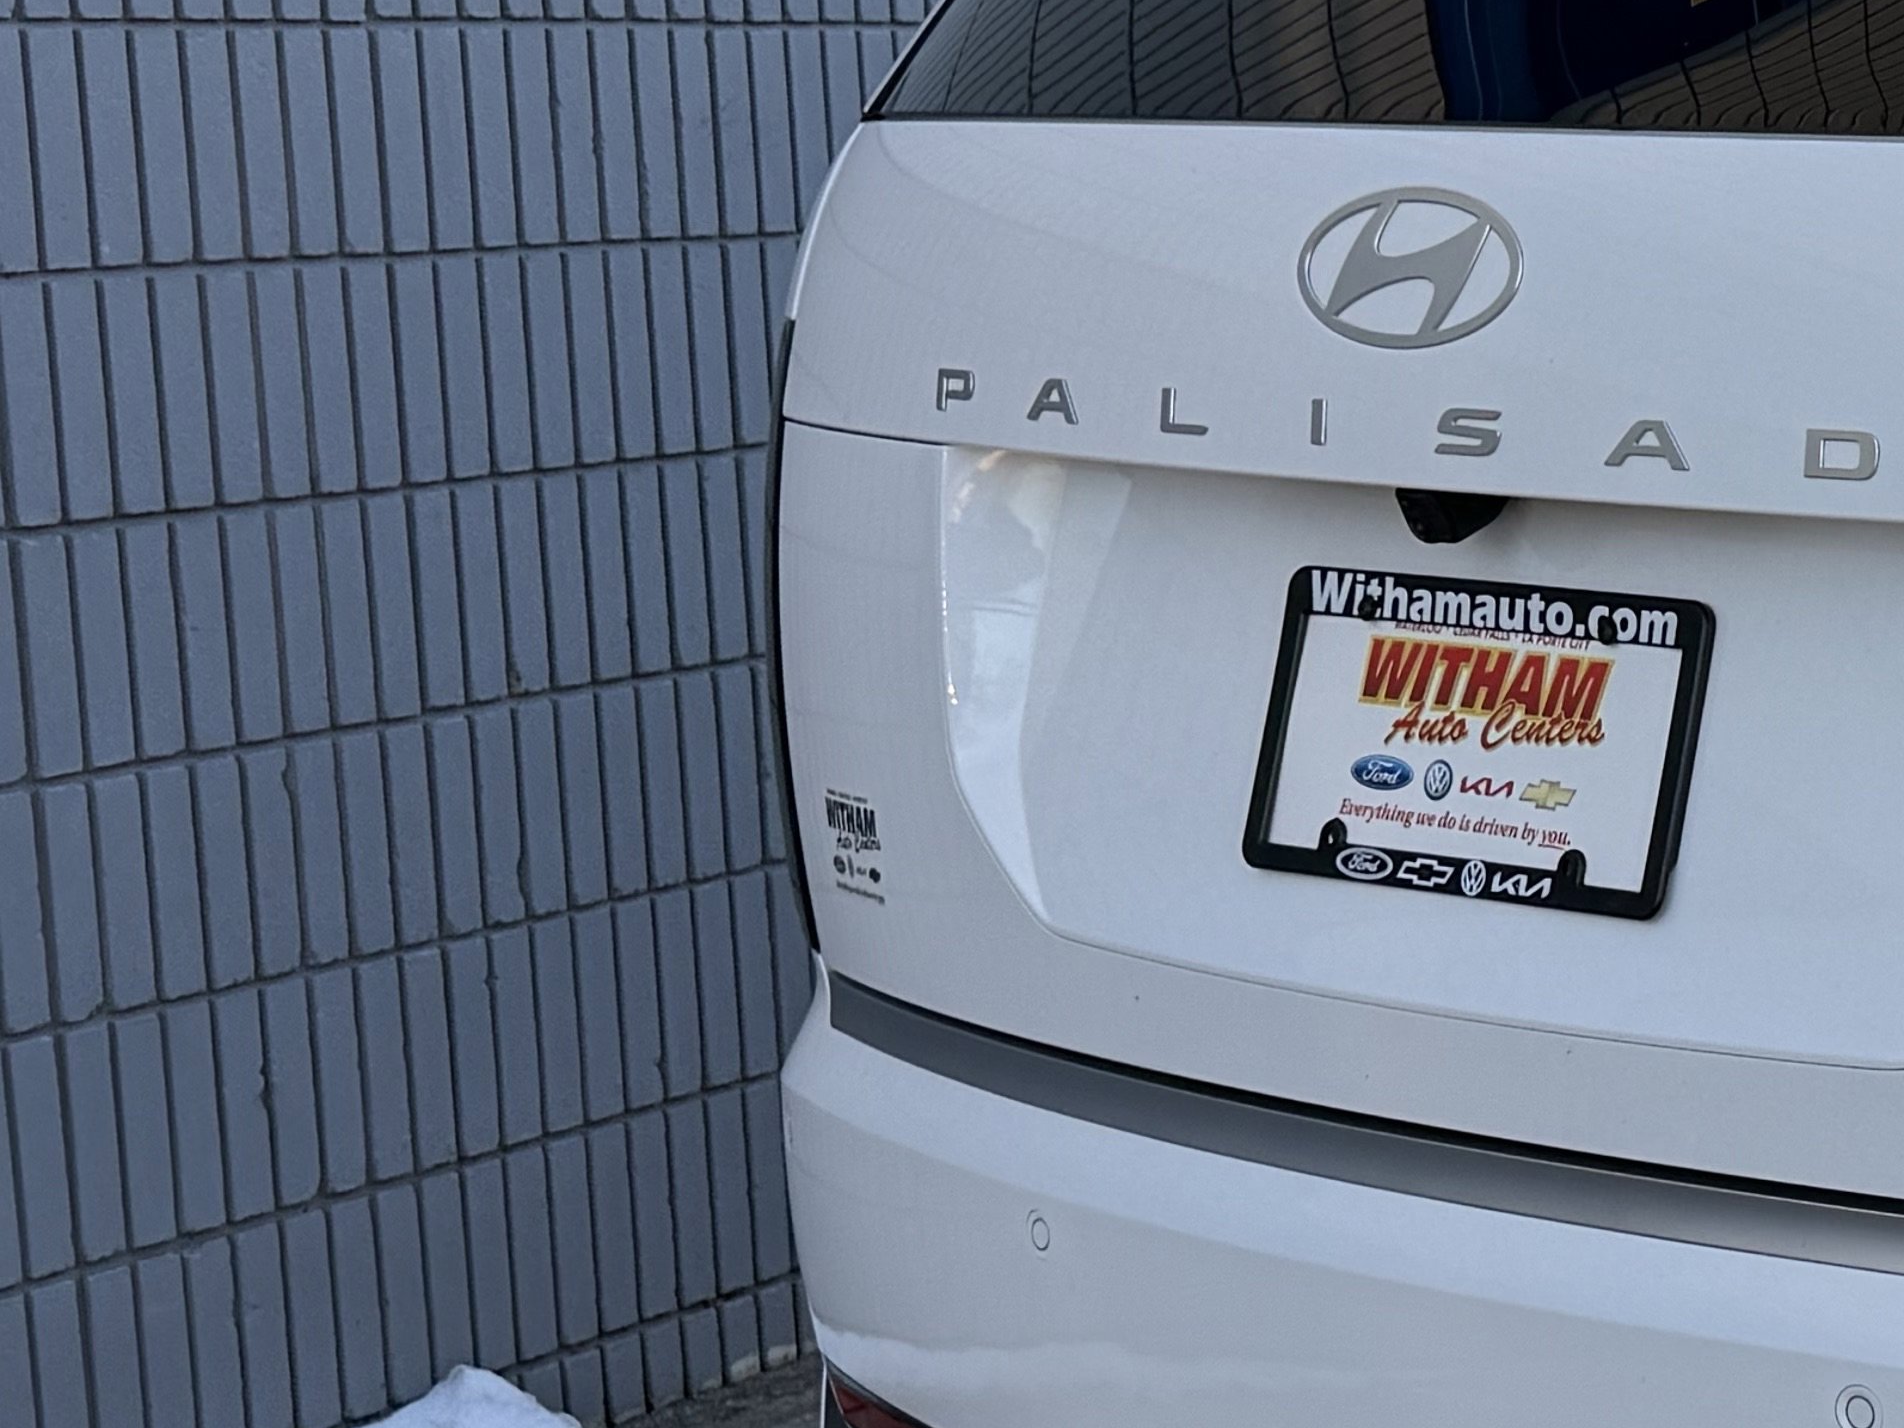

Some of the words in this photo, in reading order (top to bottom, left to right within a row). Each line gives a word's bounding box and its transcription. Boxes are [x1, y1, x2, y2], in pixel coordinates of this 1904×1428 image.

[1311, 569, 1678, 646] Withamauto.com
[1360, 635, 1613, 722] WITHAM
[1385, 700, 1468, 745] Auto
[1481, 700, 1606, 749] Centers
[1339, 797, 1412, 829] Everything
[1415, 813, 1437, 829] we
[1437, 811, 1457, 831] do
[1458, 814, 1471, 832] is
[1472, 815, 1518, 839] driven
[1521, 821, 1540, 847] by
[1538, 829, 1572, 850] you.
